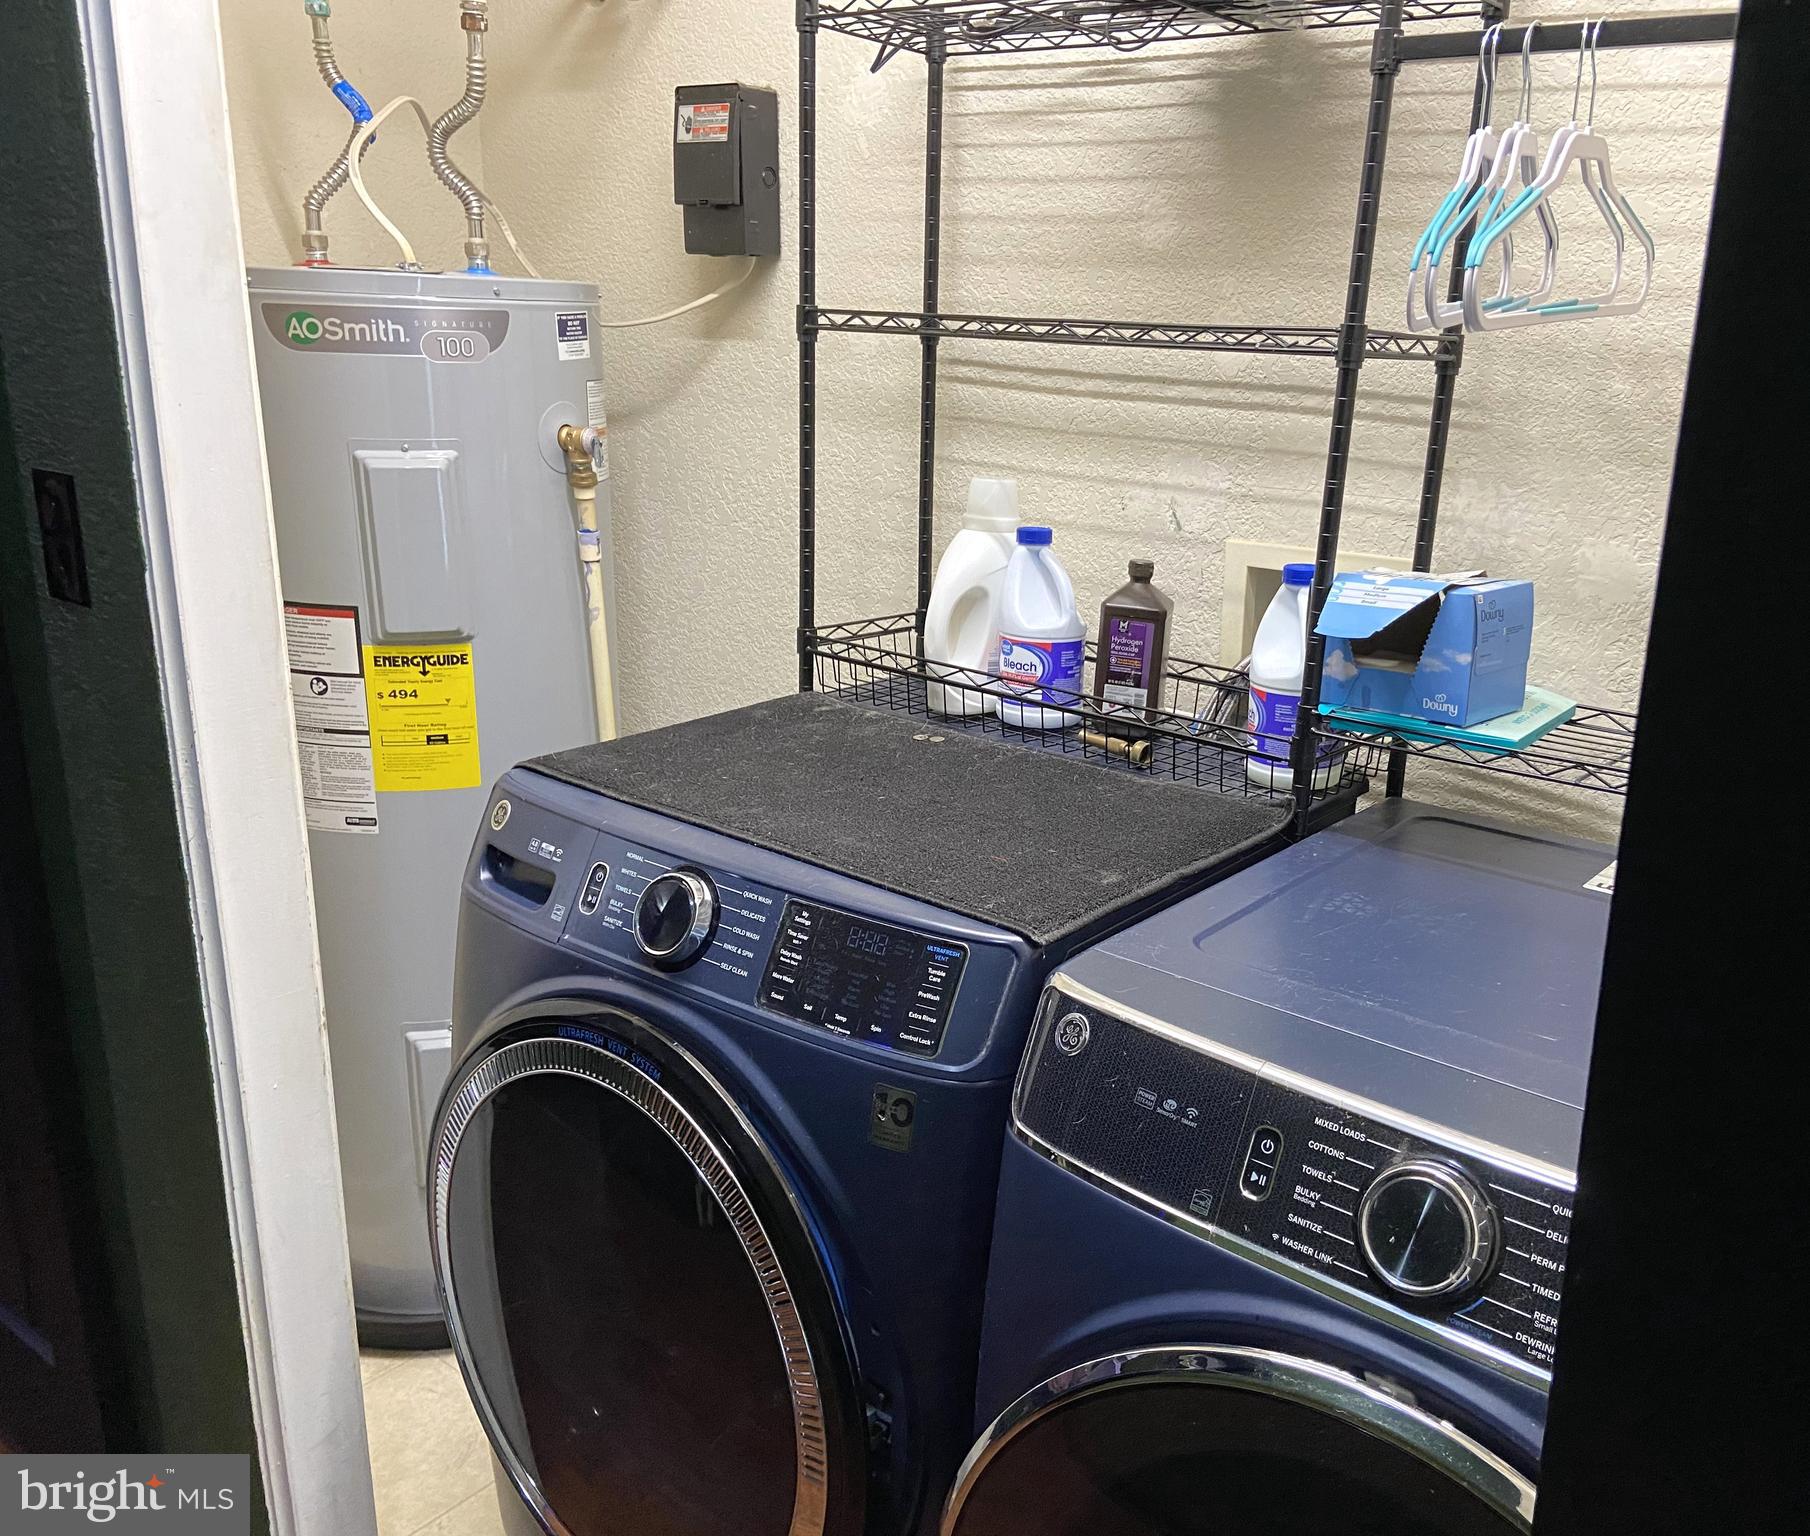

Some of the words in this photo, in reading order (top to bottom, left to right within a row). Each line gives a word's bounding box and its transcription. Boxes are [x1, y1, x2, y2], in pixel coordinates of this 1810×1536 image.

[436, 336, 475, 358] 100
[1480, 607, 1505, 623] Downy
[1110, 642, 1139, 653] Peroxide
[1111, 634, 1144, 646] Hydrogen
[373, 654, 469, 668] ENERGYGUIDE
[1003, 656, 1037, 673] Bleach
[388, 689, 419, 699] 494
[1422, 697, 1458, 717] Downy
[742, 890, 758, 901] QUICK
[758, 895, 773, 905] WASH
[740, 909, 767, 923] DELICATES
[732, 926, 746, 936] COLD
[746, 931, 760, 941] WASH
[722, 942, 737, 953] RINSE
[742, 949, 754, 959] SPIN
[926, 944, 961, 958] ULTRAFRESH
[934, 954, 949, 962] VENT
[720, 962, 732, 972] SELF
[731, 966, 749, 978] CLEAN
[770, 991, 785, 1001] Sound
[917, 990, 940, 1001] PreWash
[803, 1003, 813, 1011] Soil
[908, 1011, 922, 1020] Extra
[922, 1014, 937, 1024] Rinse
[870, 1024, 882, 1033] Spin
[899, 1032, 919, 1043] Control
[558, 1026, 604, 1046] ULTRAFRESH
[607, 1039, 629, 1057] VENT
[630, 1053, 662, 1081] SYSTEM
[1314, 1116, 1339, 1132] MIXED
[1340, 1126, 1366, 1142] LOADS
[1308, 1140, 1345, 1160] COTTONS
[1302, 1164, 1333, 1183] TOWELS
[1293, 1193, 1316, 1208] Bedding
[1295, 1185, 1321, 1201] BULKY
[1287, 1213, 1323, 1234] SANITIZE
[1545, 1229, 1569, 1244] DELI
[1281, 1236, 1314, 1256] WASHER
[1314, 1250, 1333, 1265] LINK
[1530, 1253, 1557, 1271] PERM
[1558, 1264, 1566, 1273] P
[1532, 1283, 1561, 1301] TIMED
[1533, 1310, 1558, 1328] REFR
[1534, 1320, 1553, 1333] Small
[1527, 1346, 1547, 1361] Large
